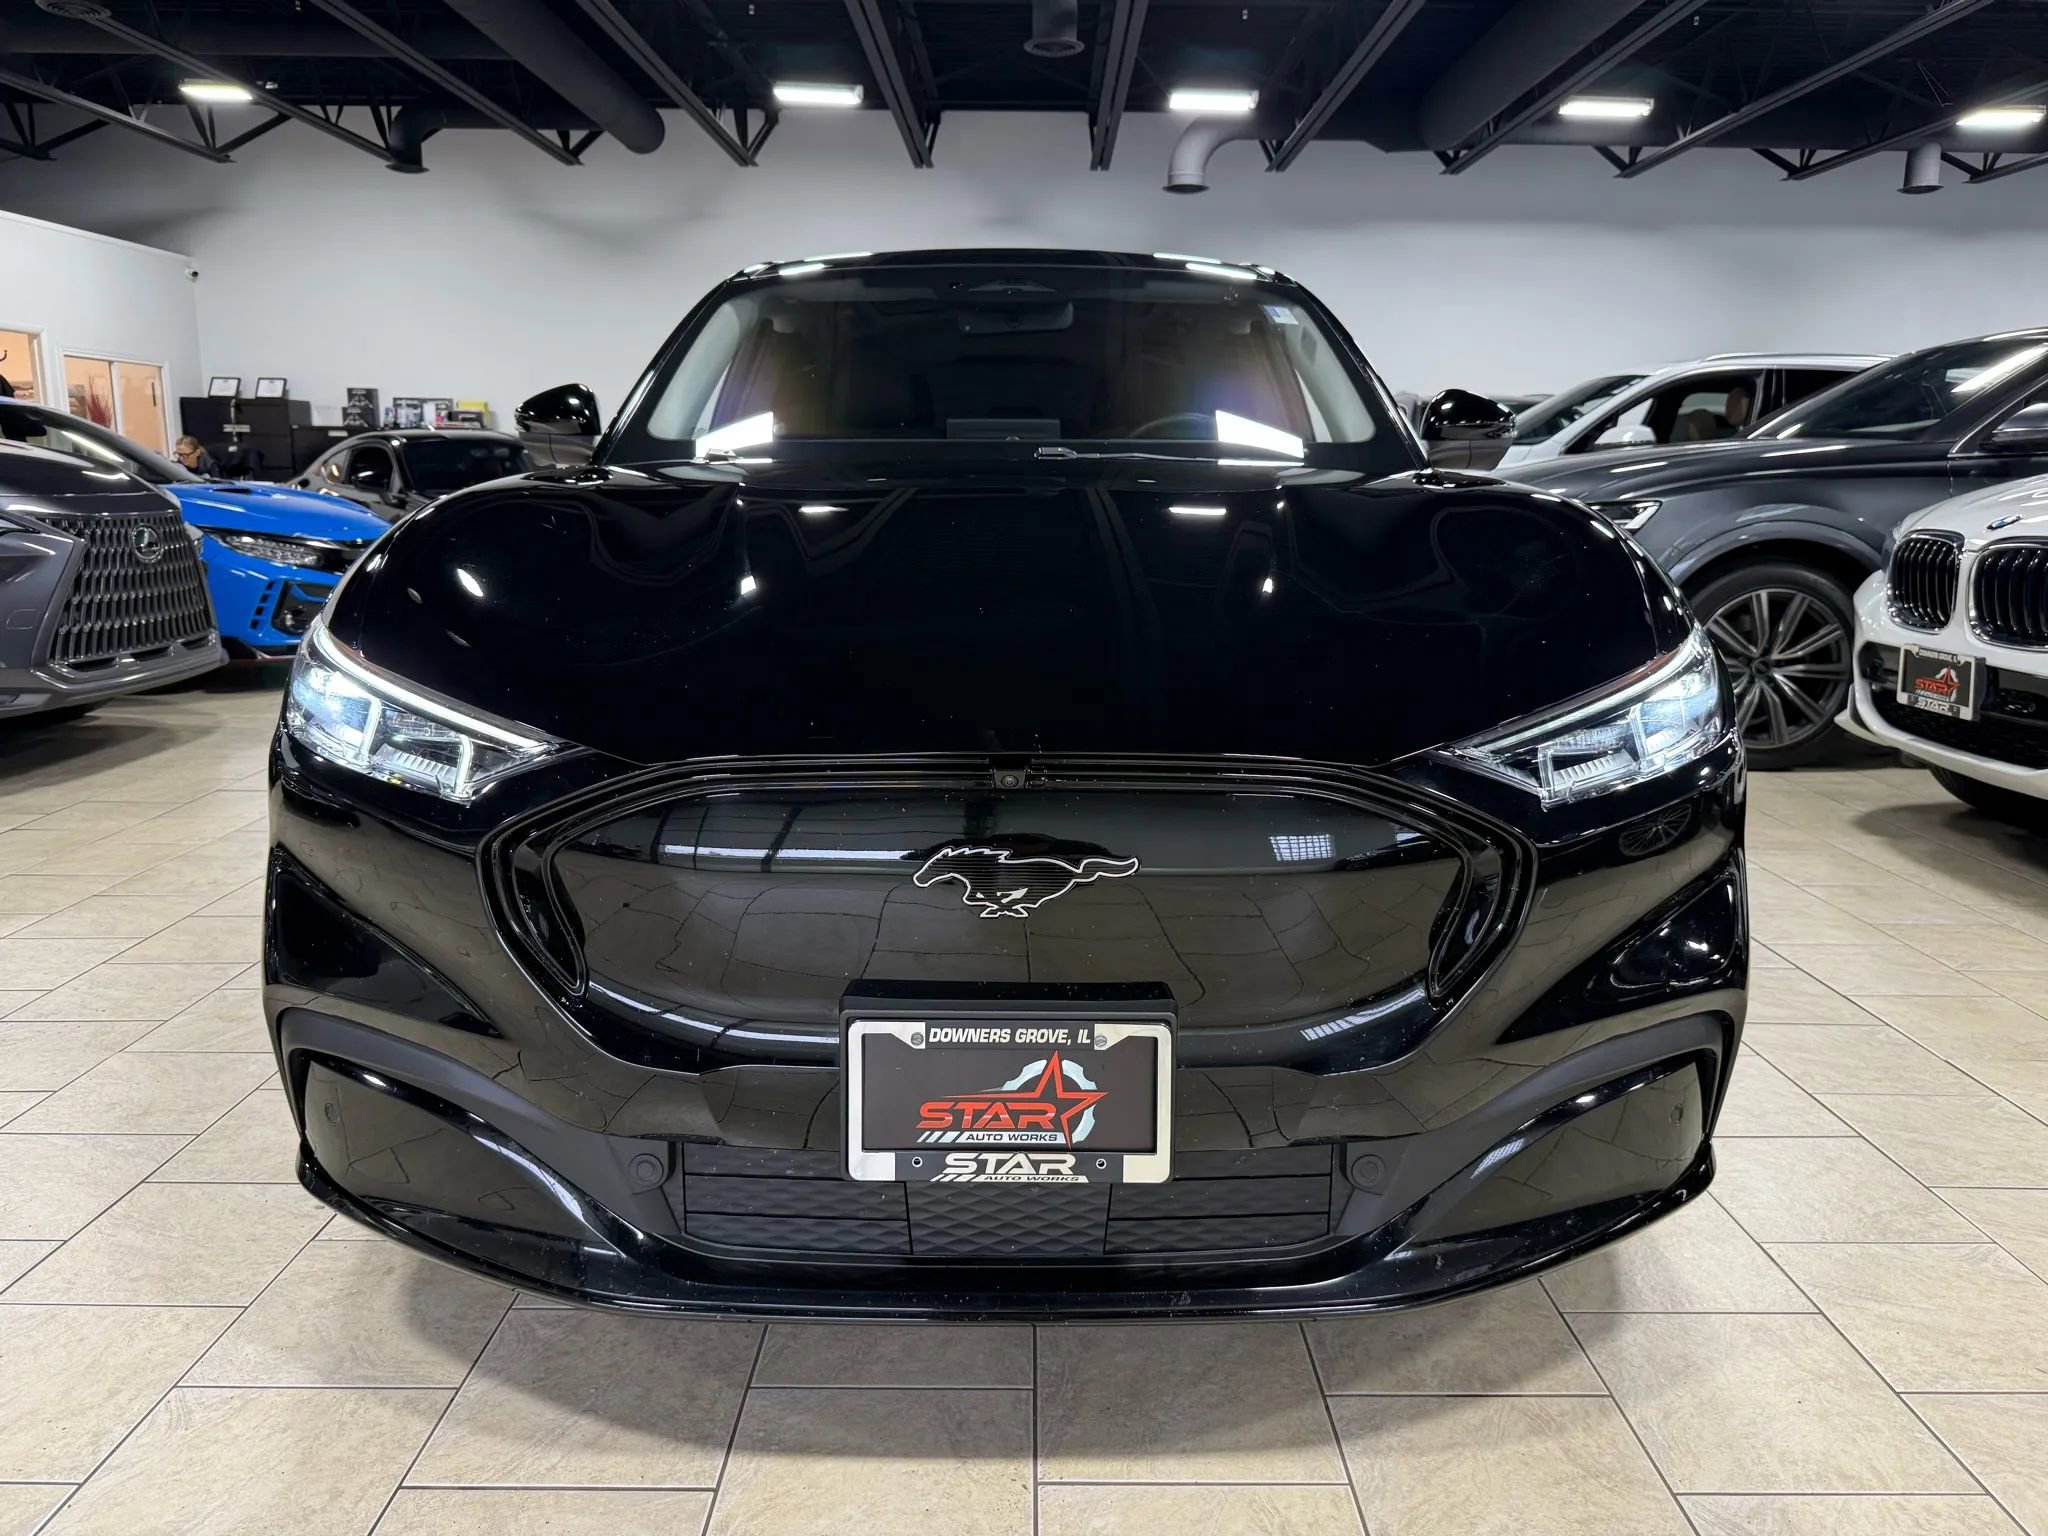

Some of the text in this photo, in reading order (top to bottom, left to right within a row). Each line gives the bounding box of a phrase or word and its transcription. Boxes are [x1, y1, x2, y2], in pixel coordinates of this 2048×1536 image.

[1914, 697, 1949, 712] STAR
[928, 1027, 1091, 1045] DOWNERS GROVE, IL
[915, 1101, 1057, 1129] STAR
[965, 1133, 1058, 1142] AUTO WORKS
[942, 1152, 1076, 1175] STAR
